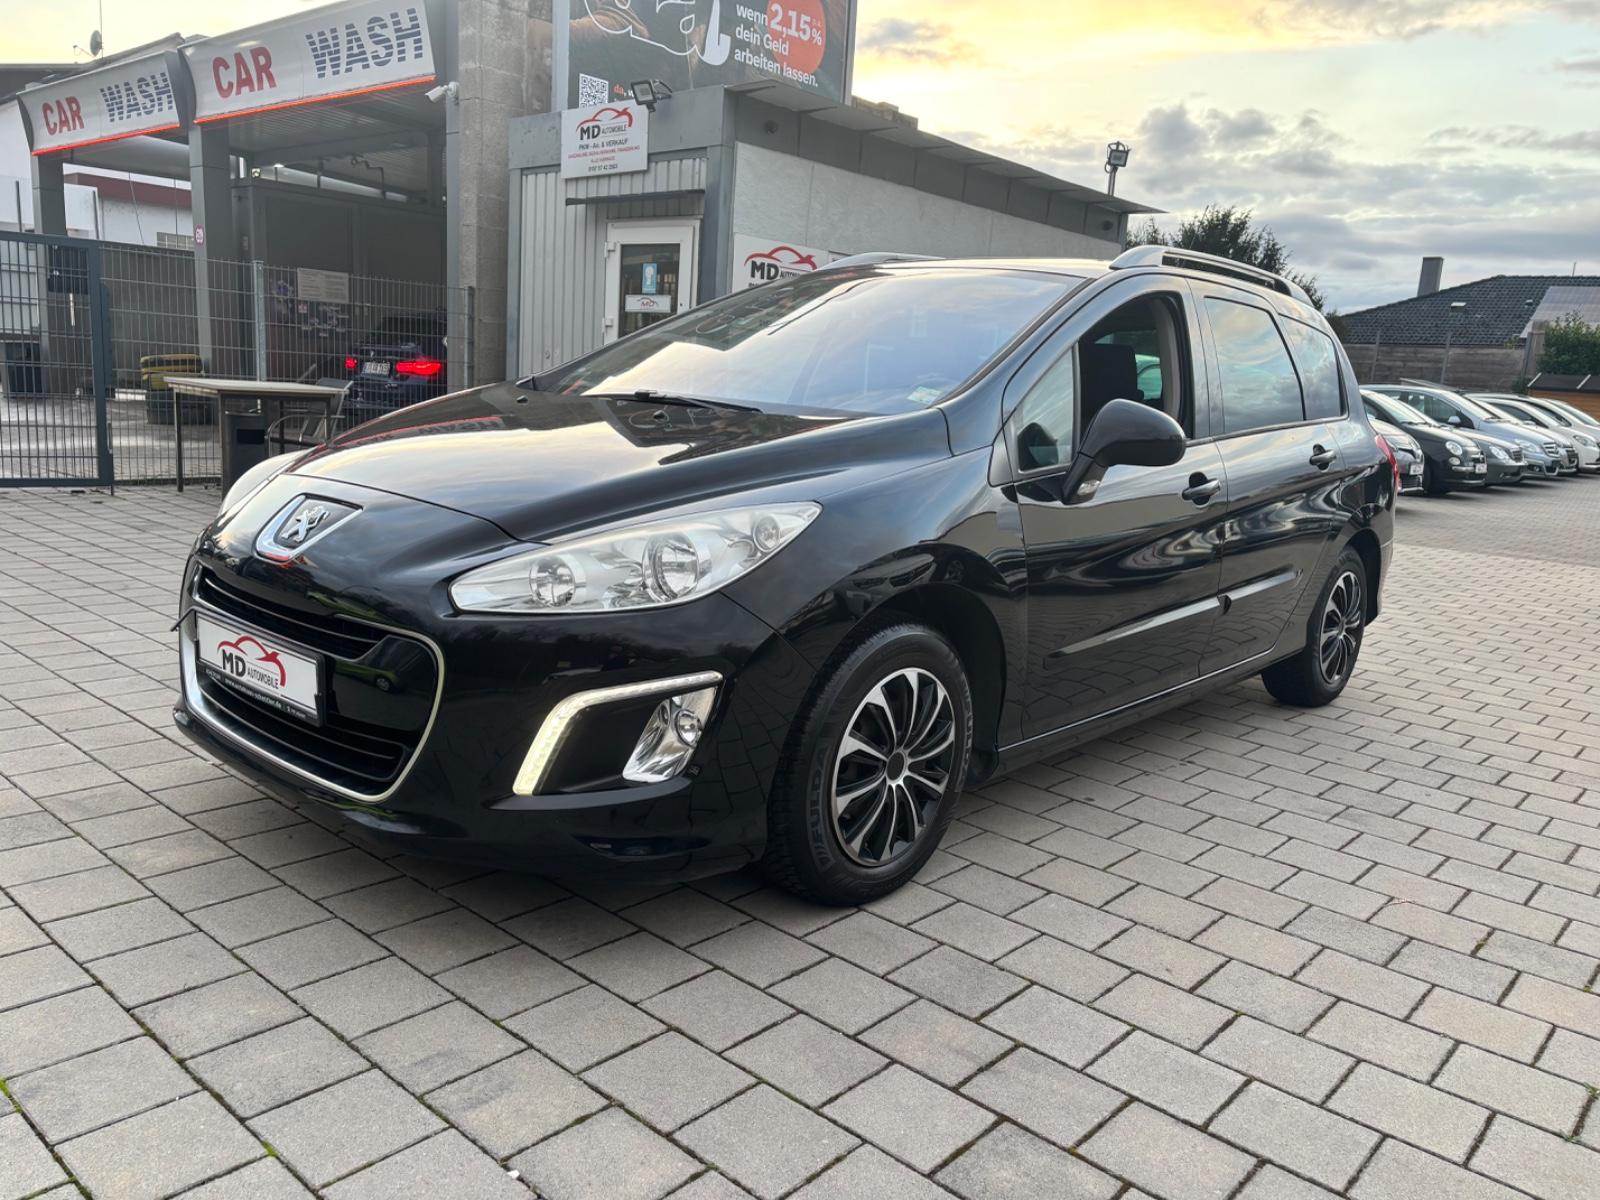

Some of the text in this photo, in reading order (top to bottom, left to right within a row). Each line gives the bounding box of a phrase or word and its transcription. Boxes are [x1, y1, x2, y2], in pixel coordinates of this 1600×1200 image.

[736, 4, 768, 26] wenn
[212, 7, 424, 99] CAR WASH
[735, 23, 790, 56] dein Geld
[734, 48, 818, 87] arbeiten lassen.
[42, 72, 174, 136] CAR WASH
[580, 125, 601, 140] MD
[750, 261, 779, 281] MD
[222, 649, 246, 678] MD
[247, 667, 279, 690] AUTOMOBILE
